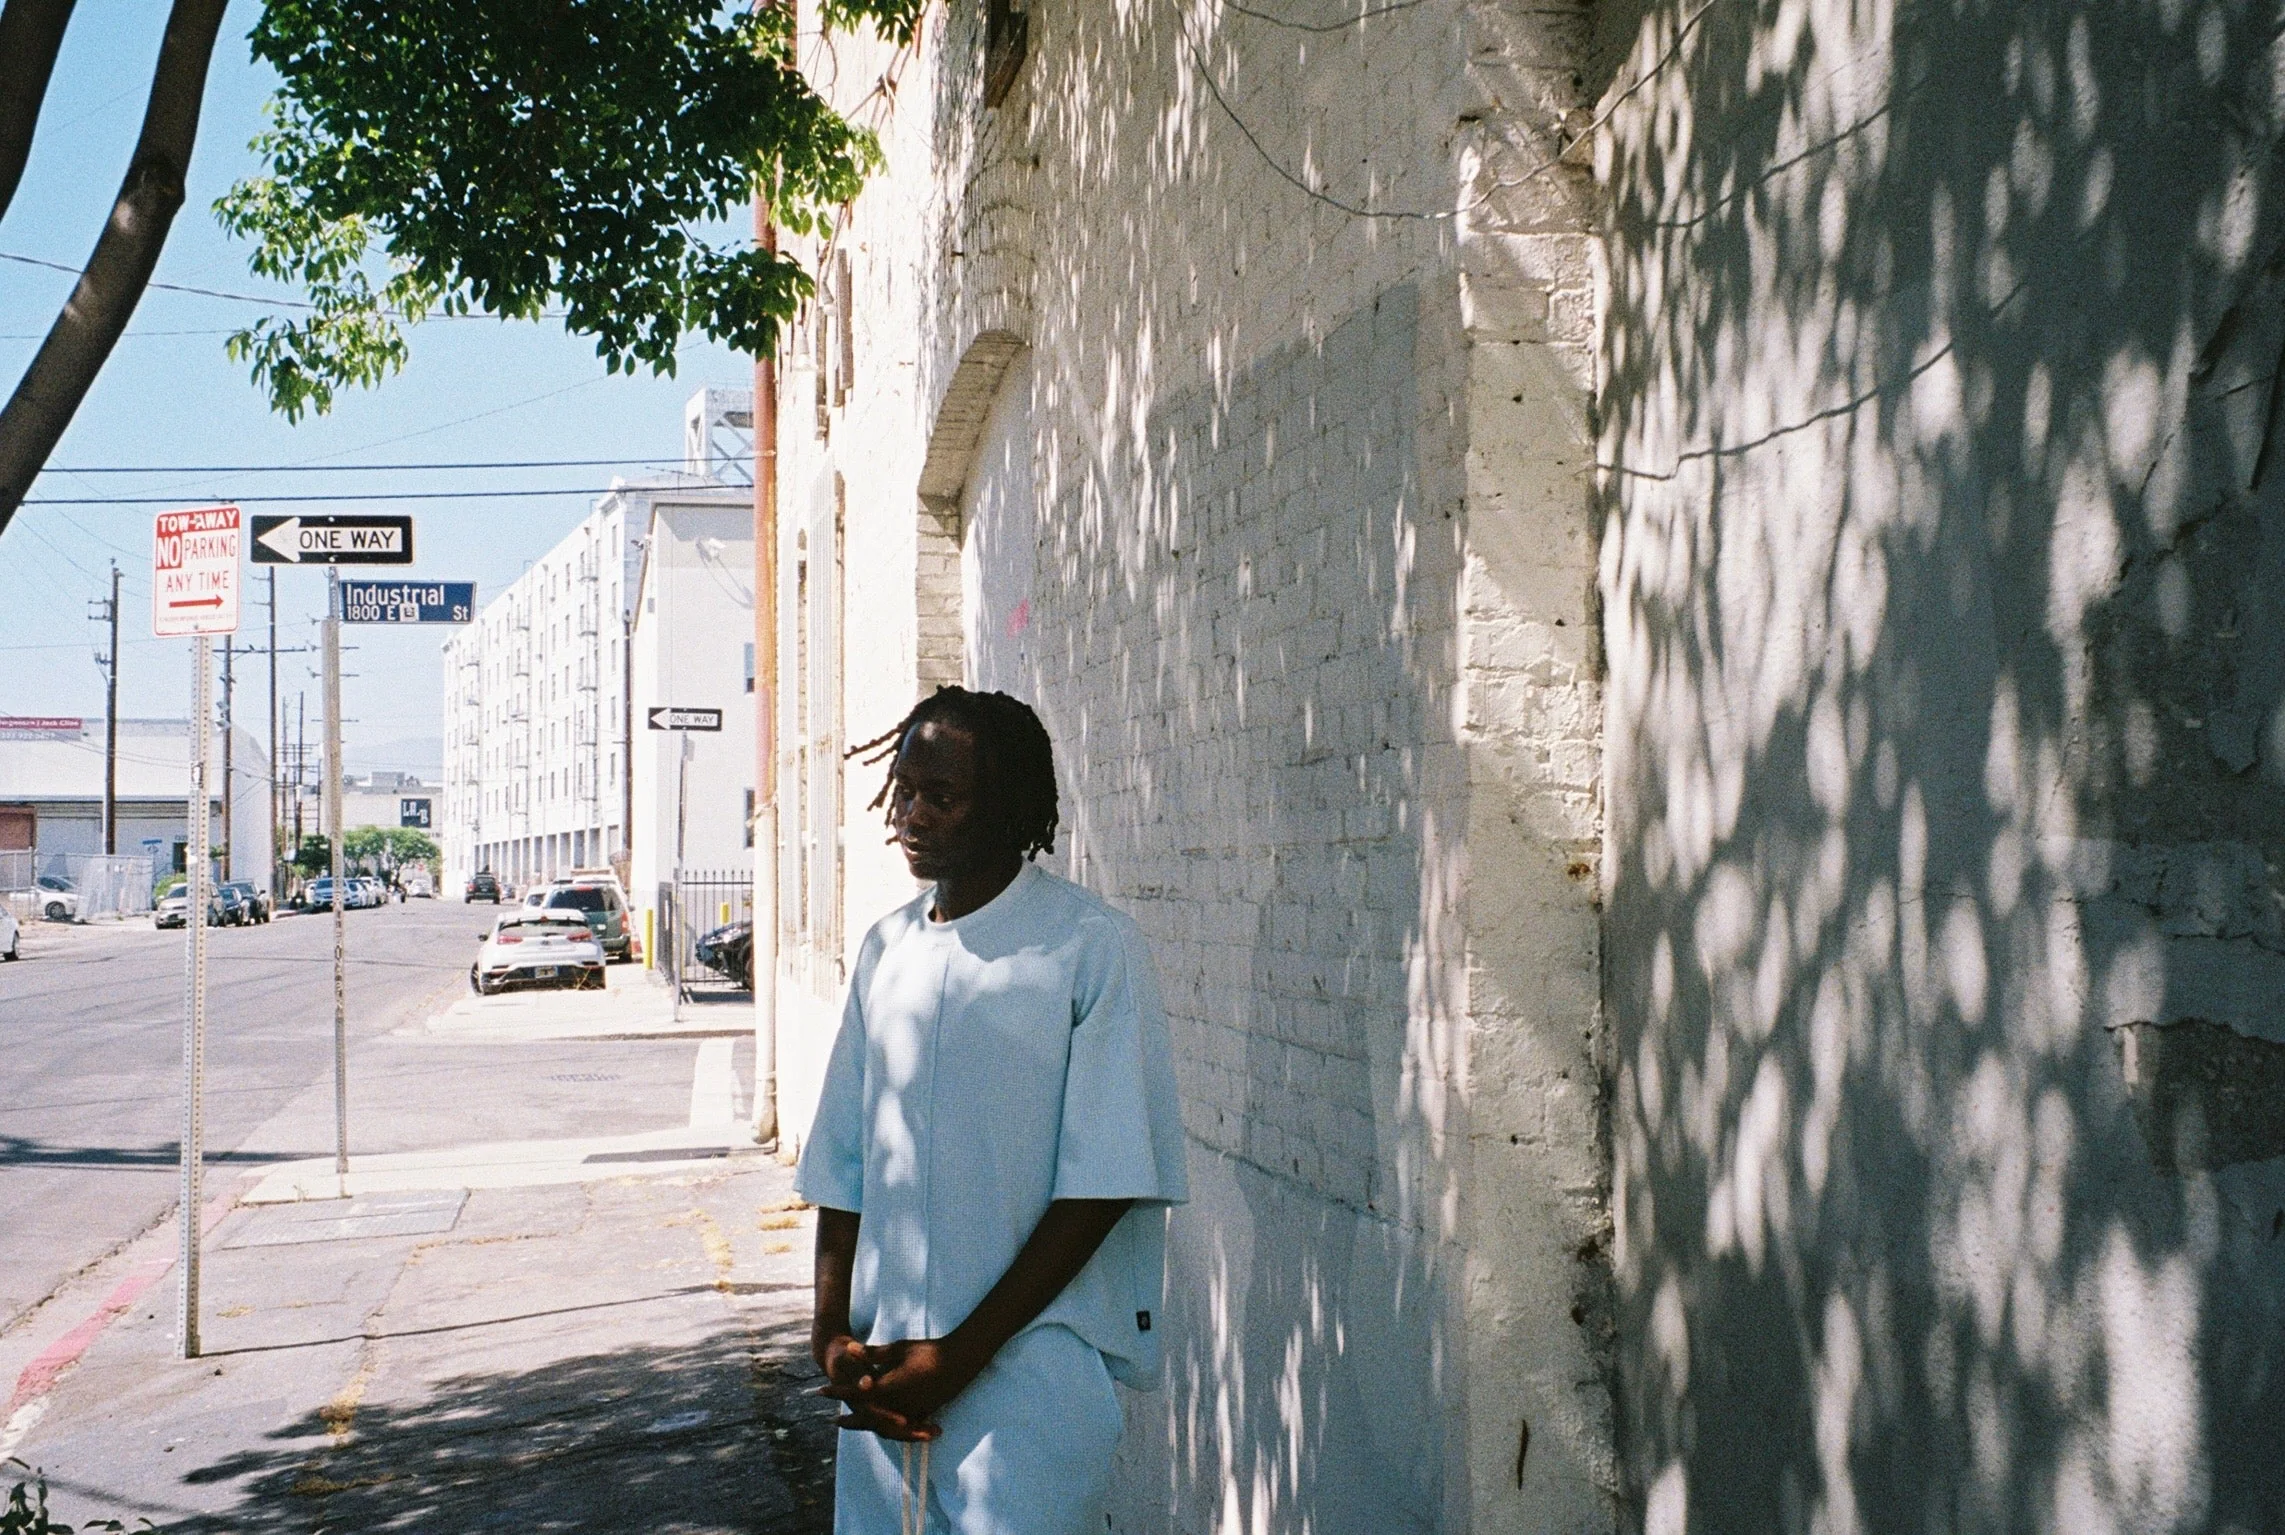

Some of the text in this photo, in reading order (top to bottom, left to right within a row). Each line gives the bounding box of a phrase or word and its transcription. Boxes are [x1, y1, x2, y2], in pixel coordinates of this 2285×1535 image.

[159, 510, 238, 533] TOW-AWAY
[156, 534, 237, 568] NO PARKING
[299, 530, 395, 549] ONE WAY
[166, 570, 229, 593] ANY TIME
[346, 583, 445, 606] Industrial
[347, 604, 469, 621] 1800 E St
[669, 714, 714, 725] ONE WAY
